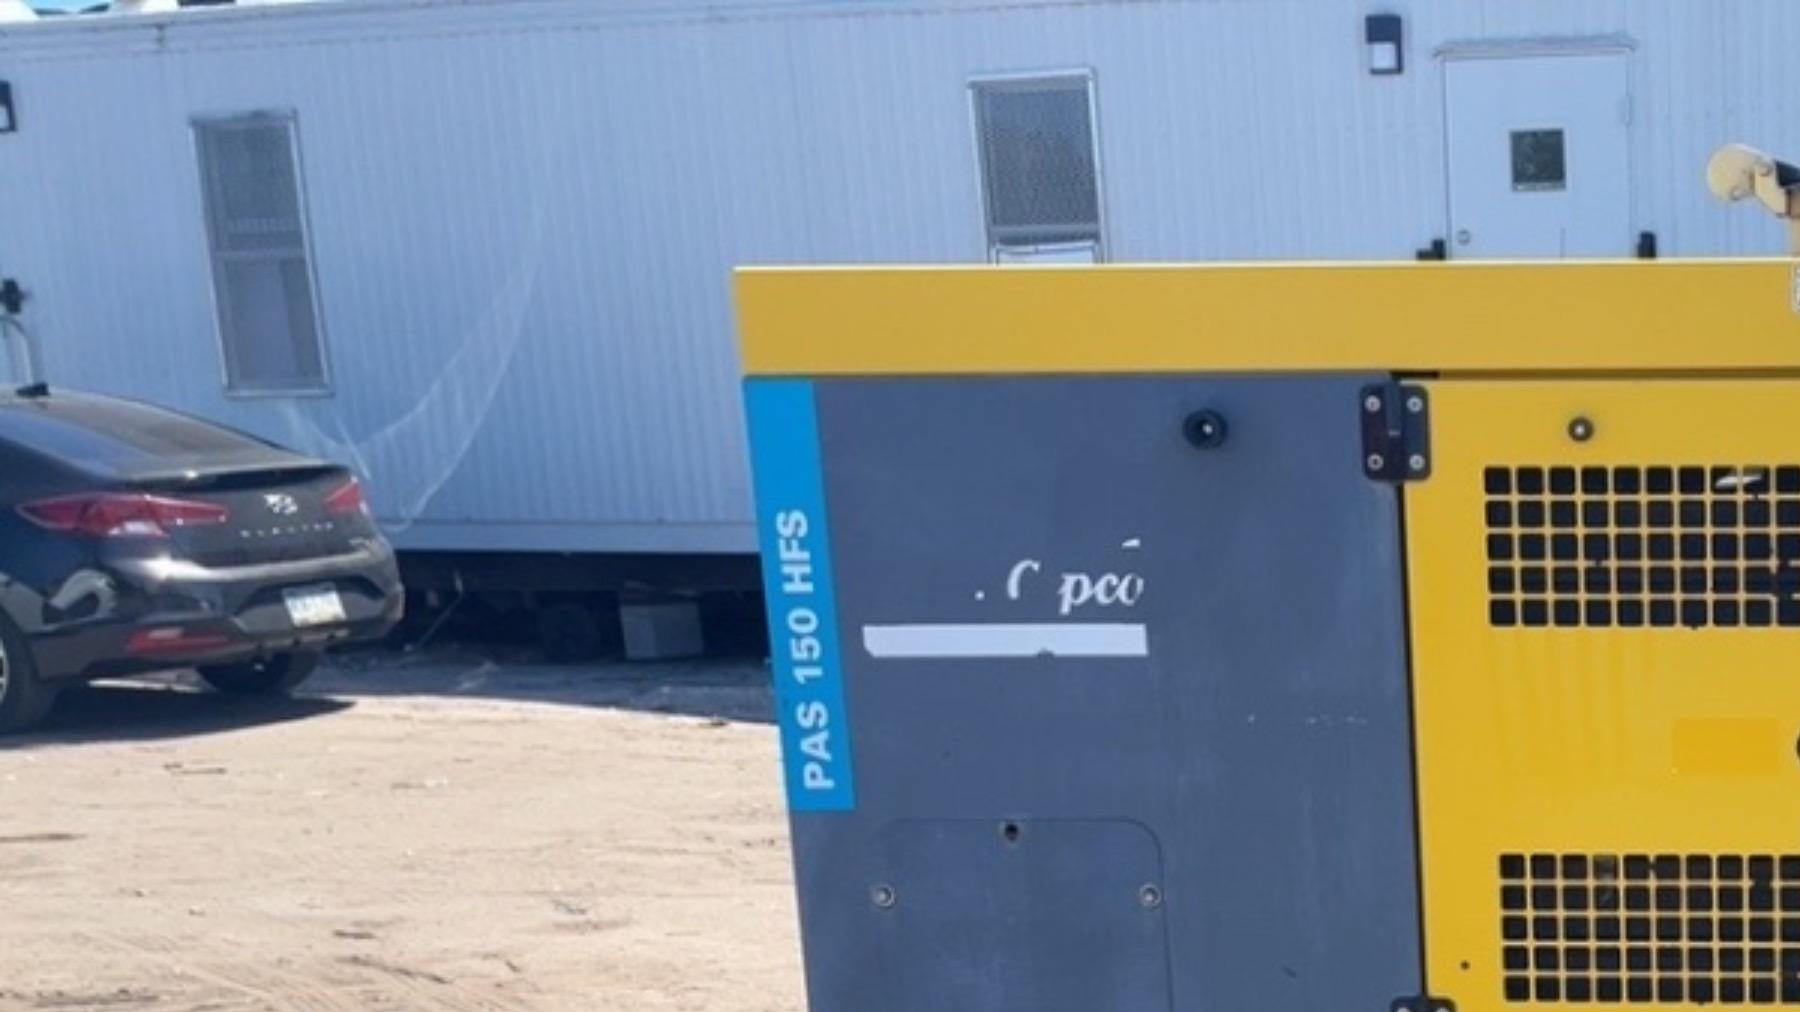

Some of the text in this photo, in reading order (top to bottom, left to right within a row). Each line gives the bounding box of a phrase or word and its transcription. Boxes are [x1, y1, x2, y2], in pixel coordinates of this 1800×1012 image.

[775, 508, 836, 790] PAS 150 HFS
